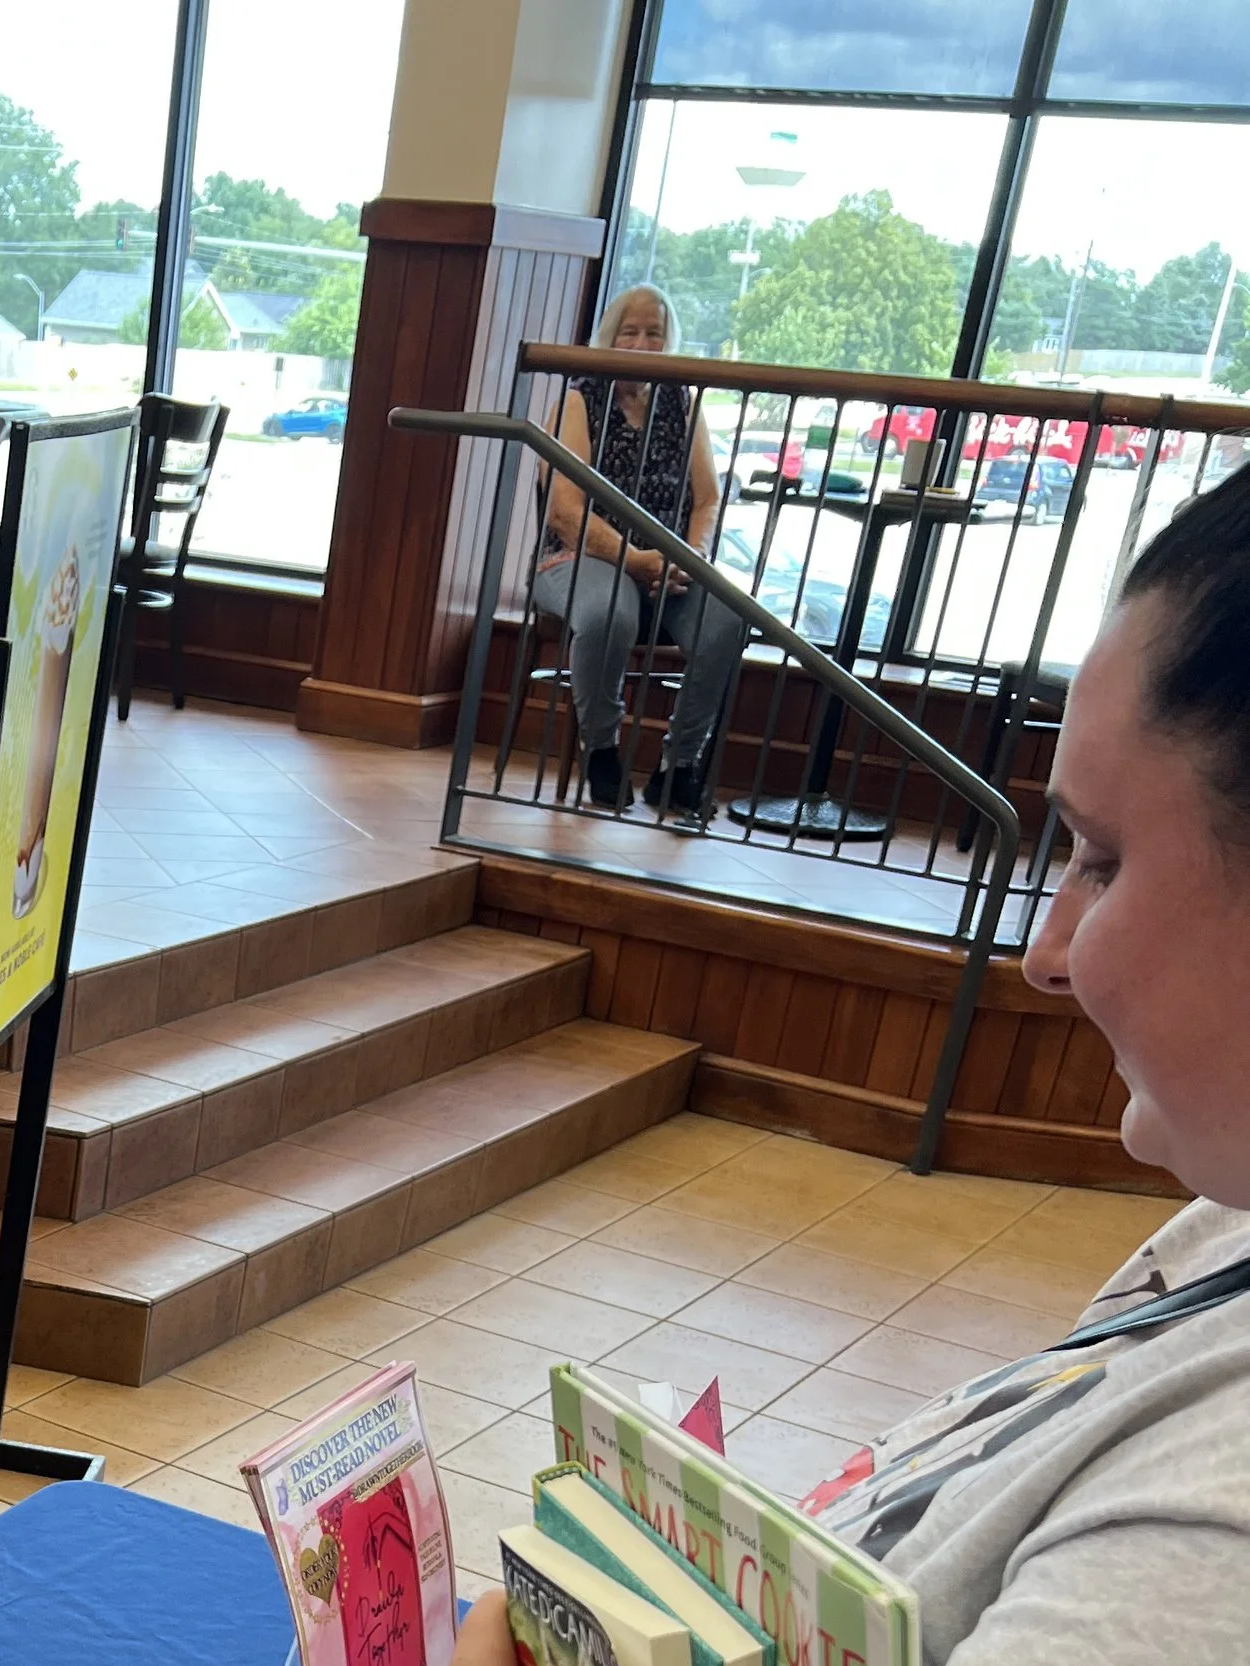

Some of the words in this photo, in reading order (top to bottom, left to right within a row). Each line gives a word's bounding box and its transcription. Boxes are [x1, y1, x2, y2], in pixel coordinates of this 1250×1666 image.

[290, 1429, 350, 1484] DISCOVER
[349, 1409, 376, 1442] THE
[372, 1393, 398, 1427] NEW
[298, 1446, 368, 1507] MUST-READ
[363, 1420, 402, 1461] NOVEL
[657, 1472, 683, 1499] Times
[683, 1490, 733, 1536] Bestselling
[734, 1526, 757, 1551] Food
